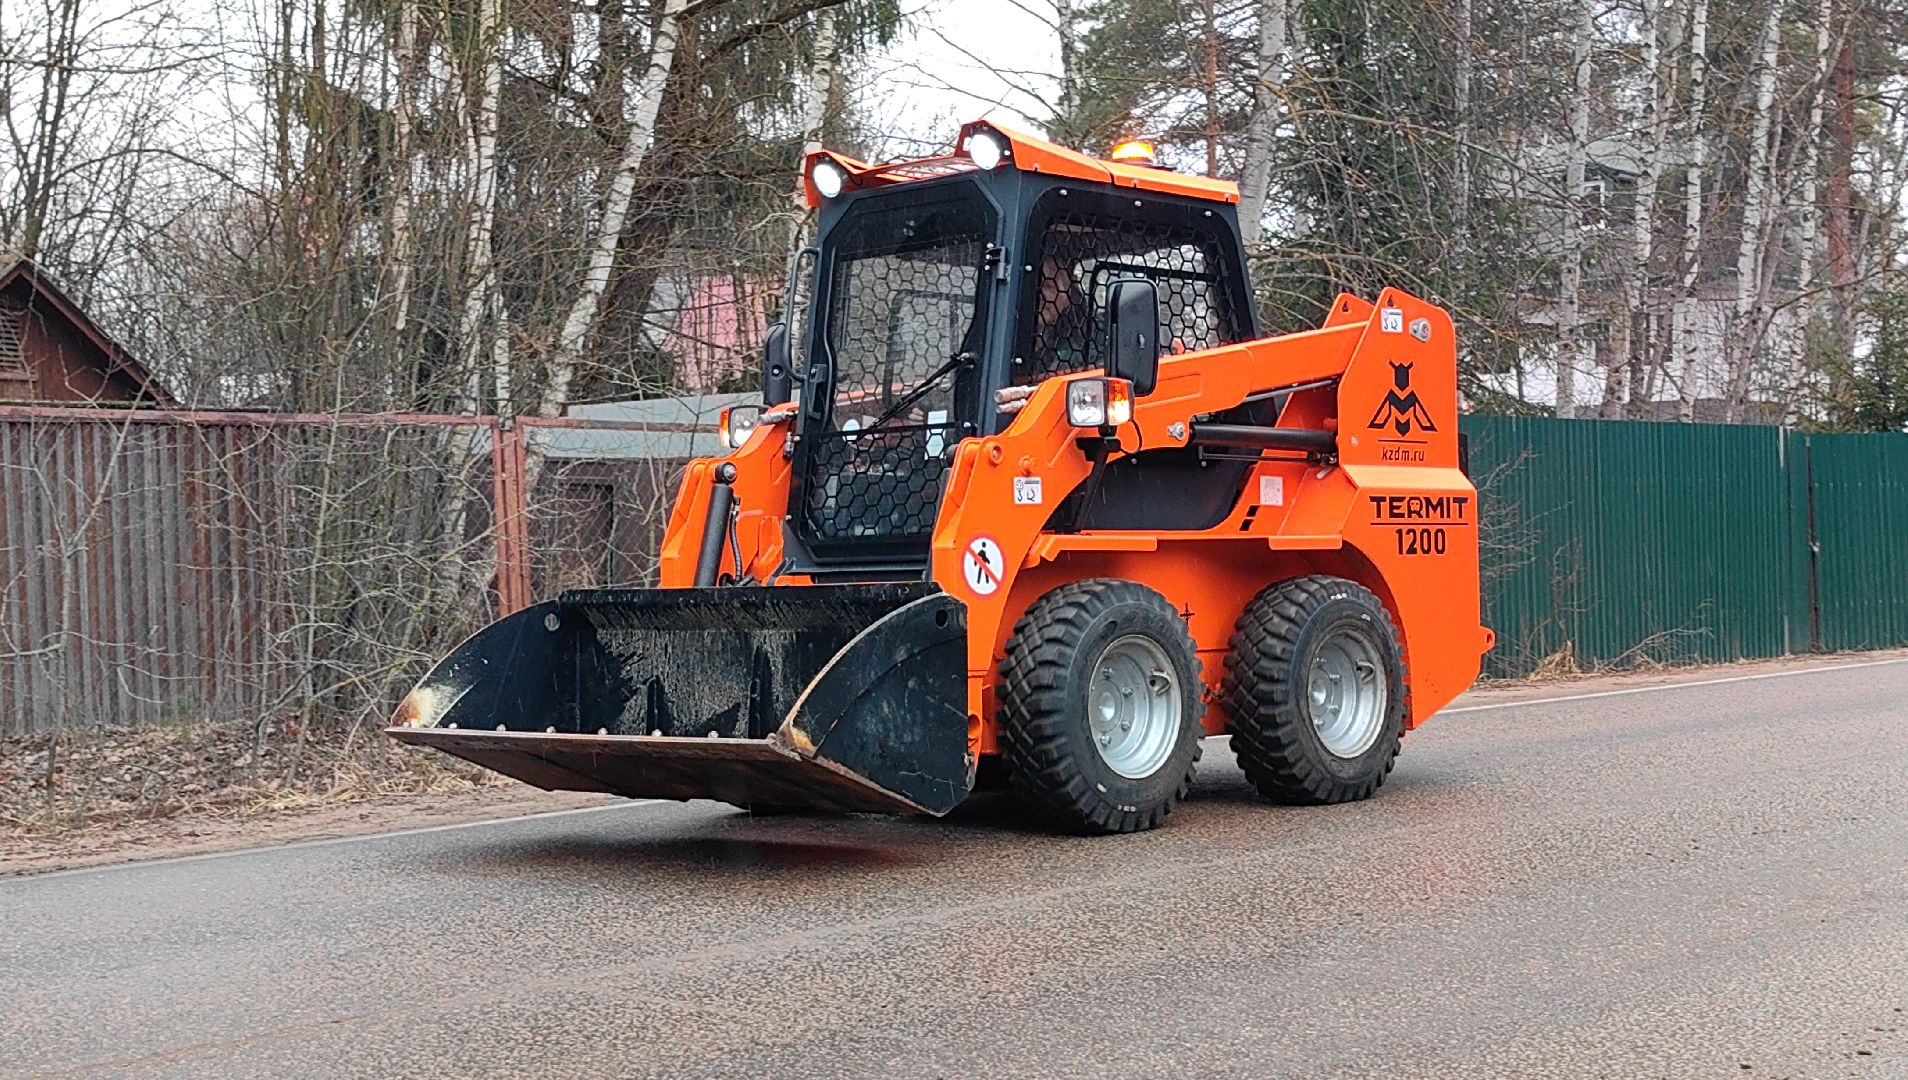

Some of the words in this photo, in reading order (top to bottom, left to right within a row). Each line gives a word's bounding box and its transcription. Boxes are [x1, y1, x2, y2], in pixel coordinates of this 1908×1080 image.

[1381, 446, 1425, 462] kzdm.ru
[1369, 496, 1469, 518] TERMIT
[1395, 528, 1446, 555] 1200
